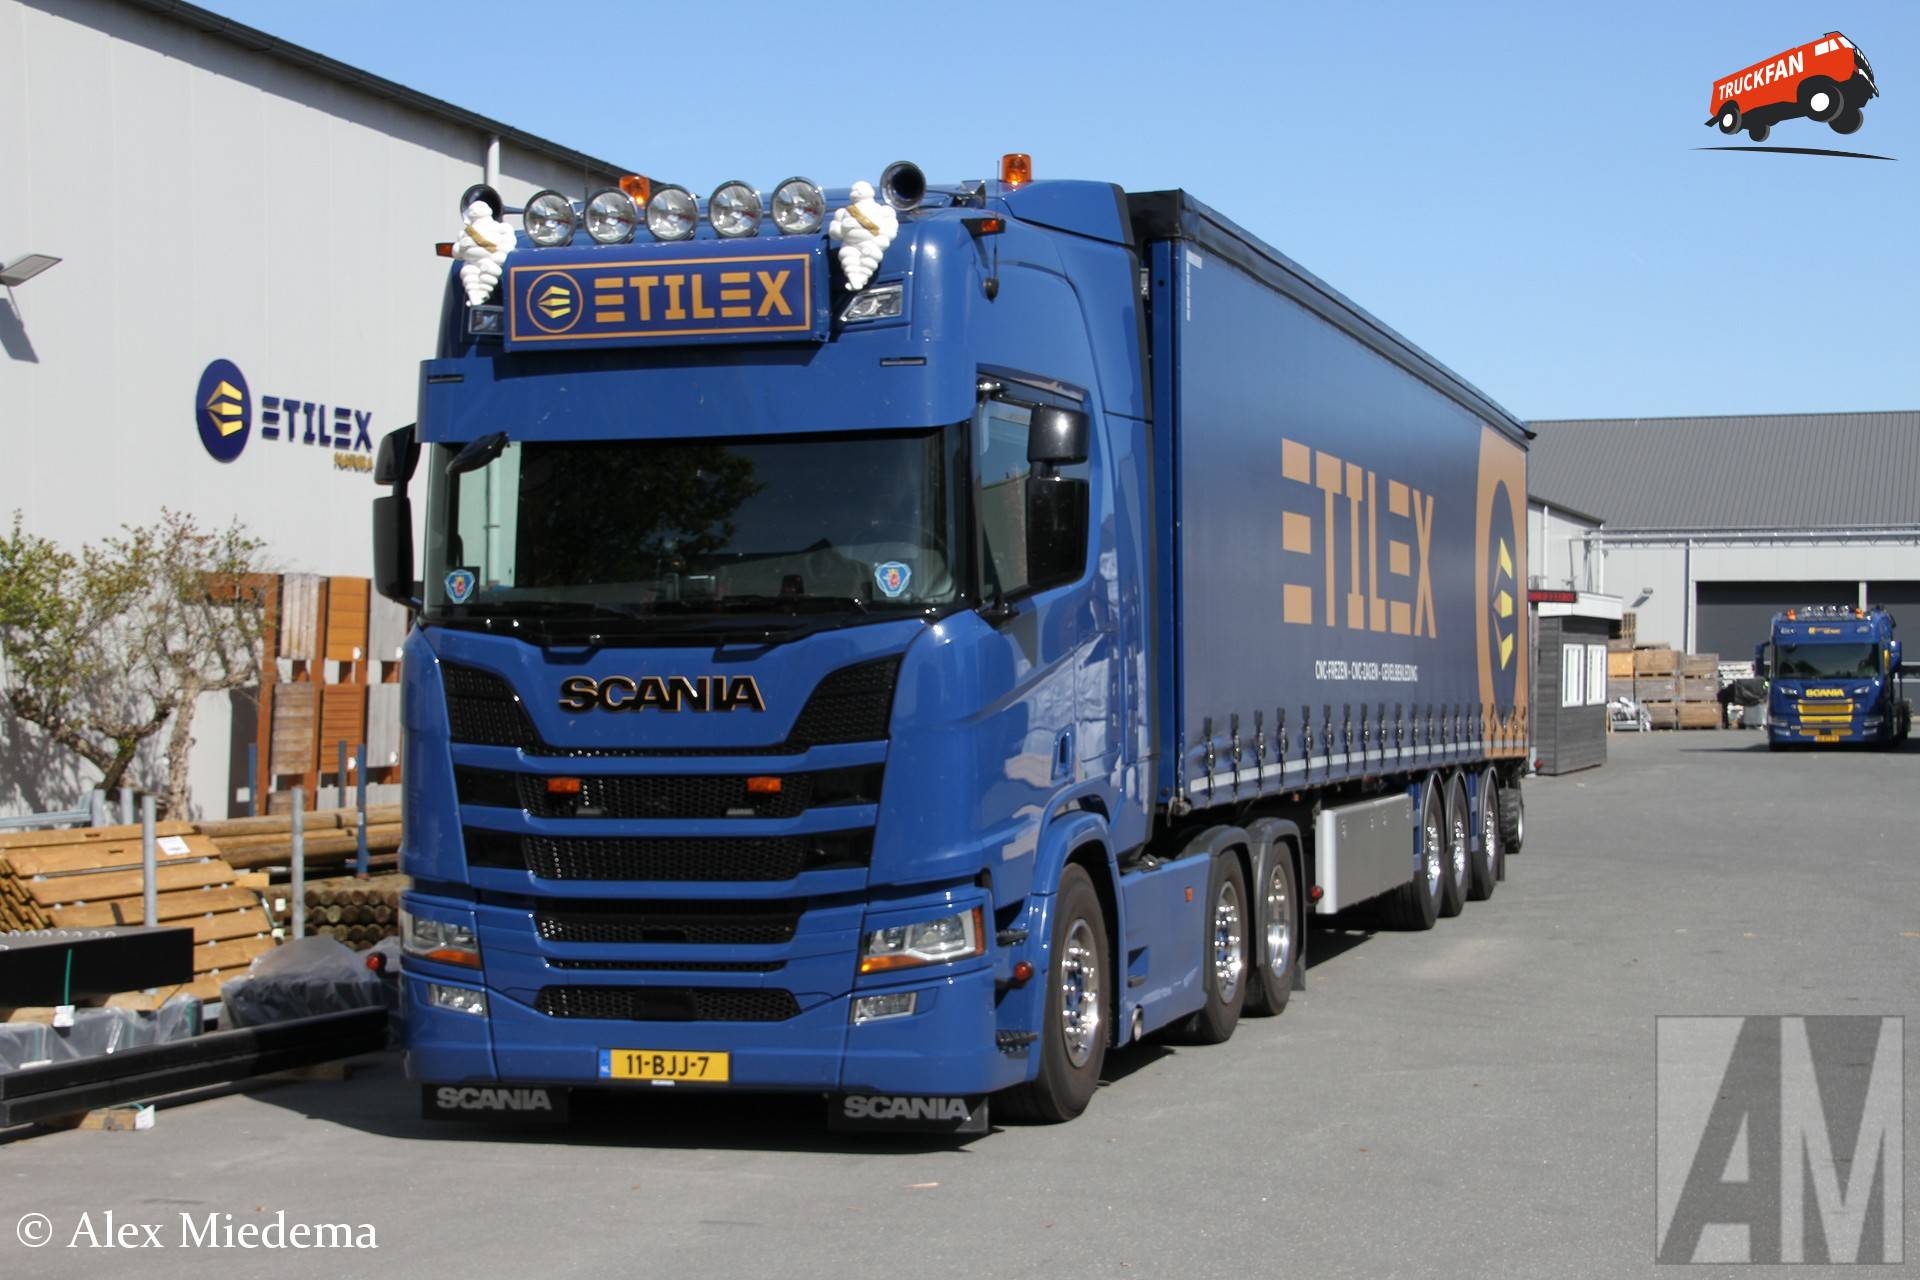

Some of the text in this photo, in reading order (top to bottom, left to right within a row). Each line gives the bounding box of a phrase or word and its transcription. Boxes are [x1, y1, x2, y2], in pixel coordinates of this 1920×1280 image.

[594, 270, 793, 324] ETILEX
[261, 395, 373, 453] ETILEX
[1281, 437, 1437, 639] ETILEX
[558, 675, 767, 713] SCANIA
[1806, 688, 1845, 698] SCANIA
[626, 1054, 710, 1078] 11-BJJ-7
[436, 1086, 552, 1111] SCANIA
[843, 1095, 971, 1121] SCANIA
